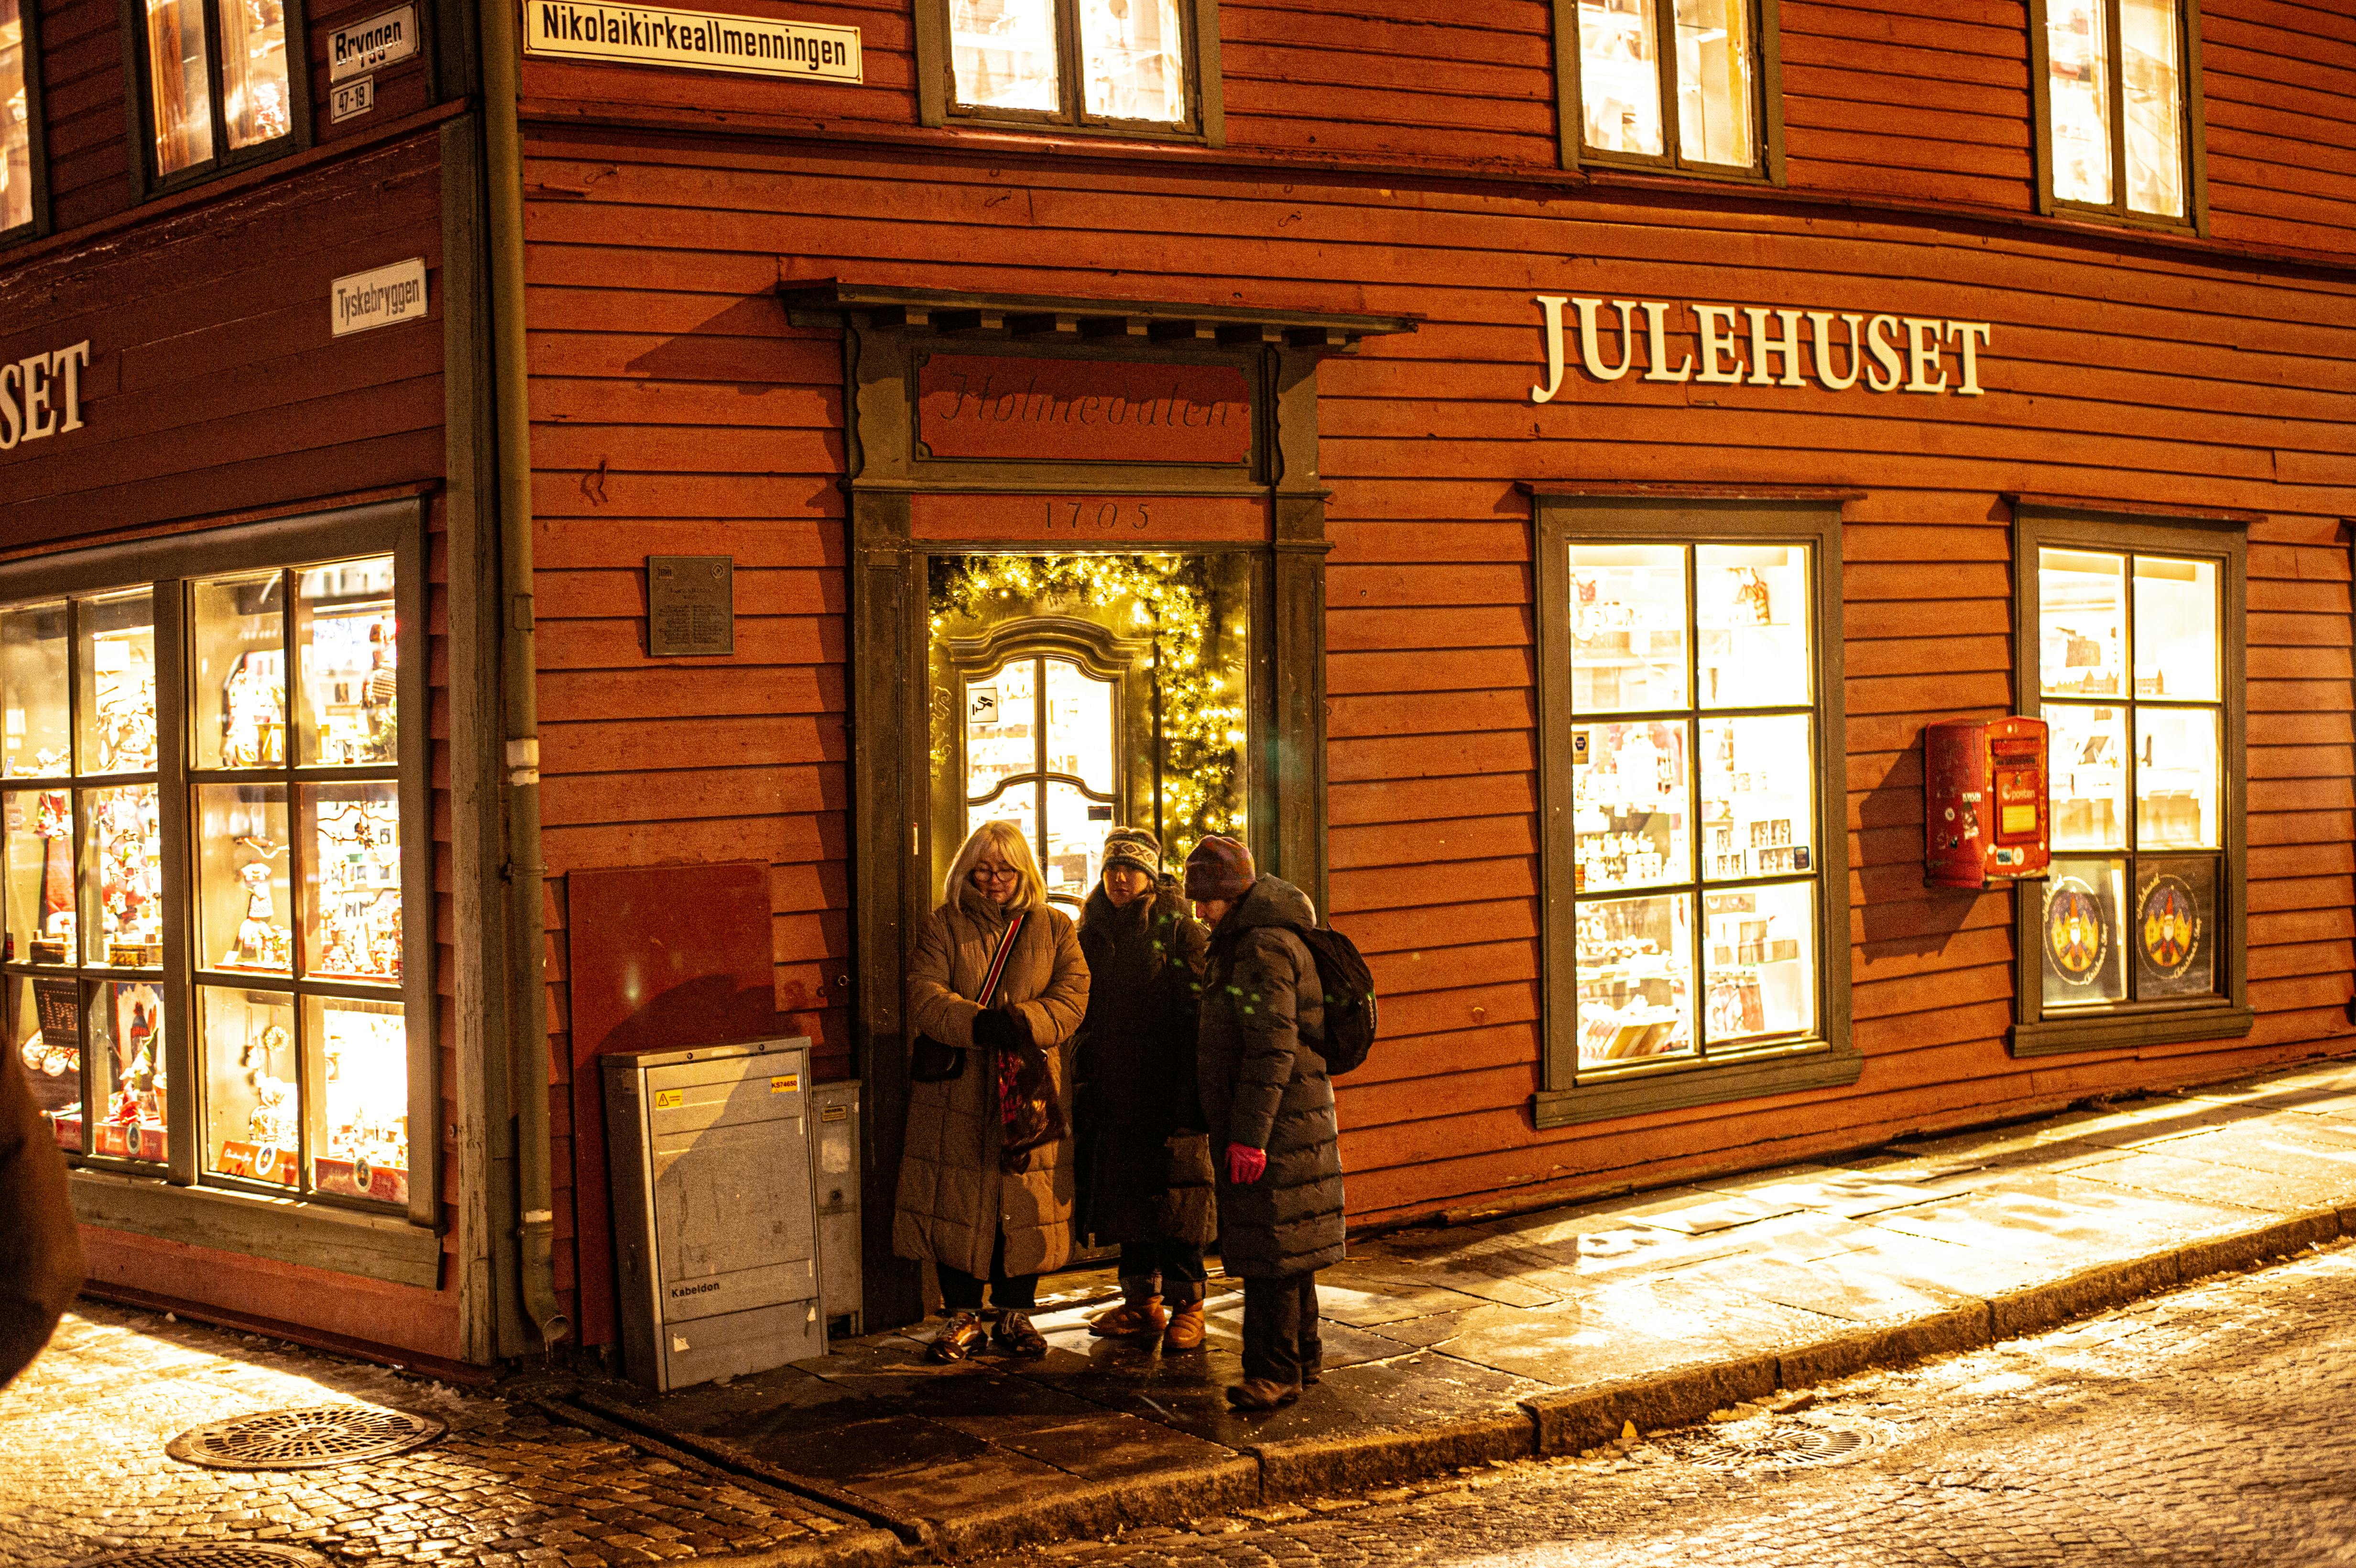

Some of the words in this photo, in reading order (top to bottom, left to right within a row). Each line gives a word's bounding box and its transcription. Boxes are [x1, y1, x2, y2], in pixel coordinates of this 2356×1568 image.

[336, 21, 402, 68] Bryggen
[543, 2, 846, 70] Nikolaikirkeallmenningen
[338, 86, 365, 113] 47-19
[338, 279, 420, 326] Tyskebryggen
[1532, 295, 1990, 403] JULEHUSET
[0, 339, 90, 449] SET
[940, 371, 1229, 428] Holmedalen
[1045, 502, 1148, 529] 1705
[771, 1080, 797, 1088] KS74650
[671, 1282, 720, 1298] Kabeldon
